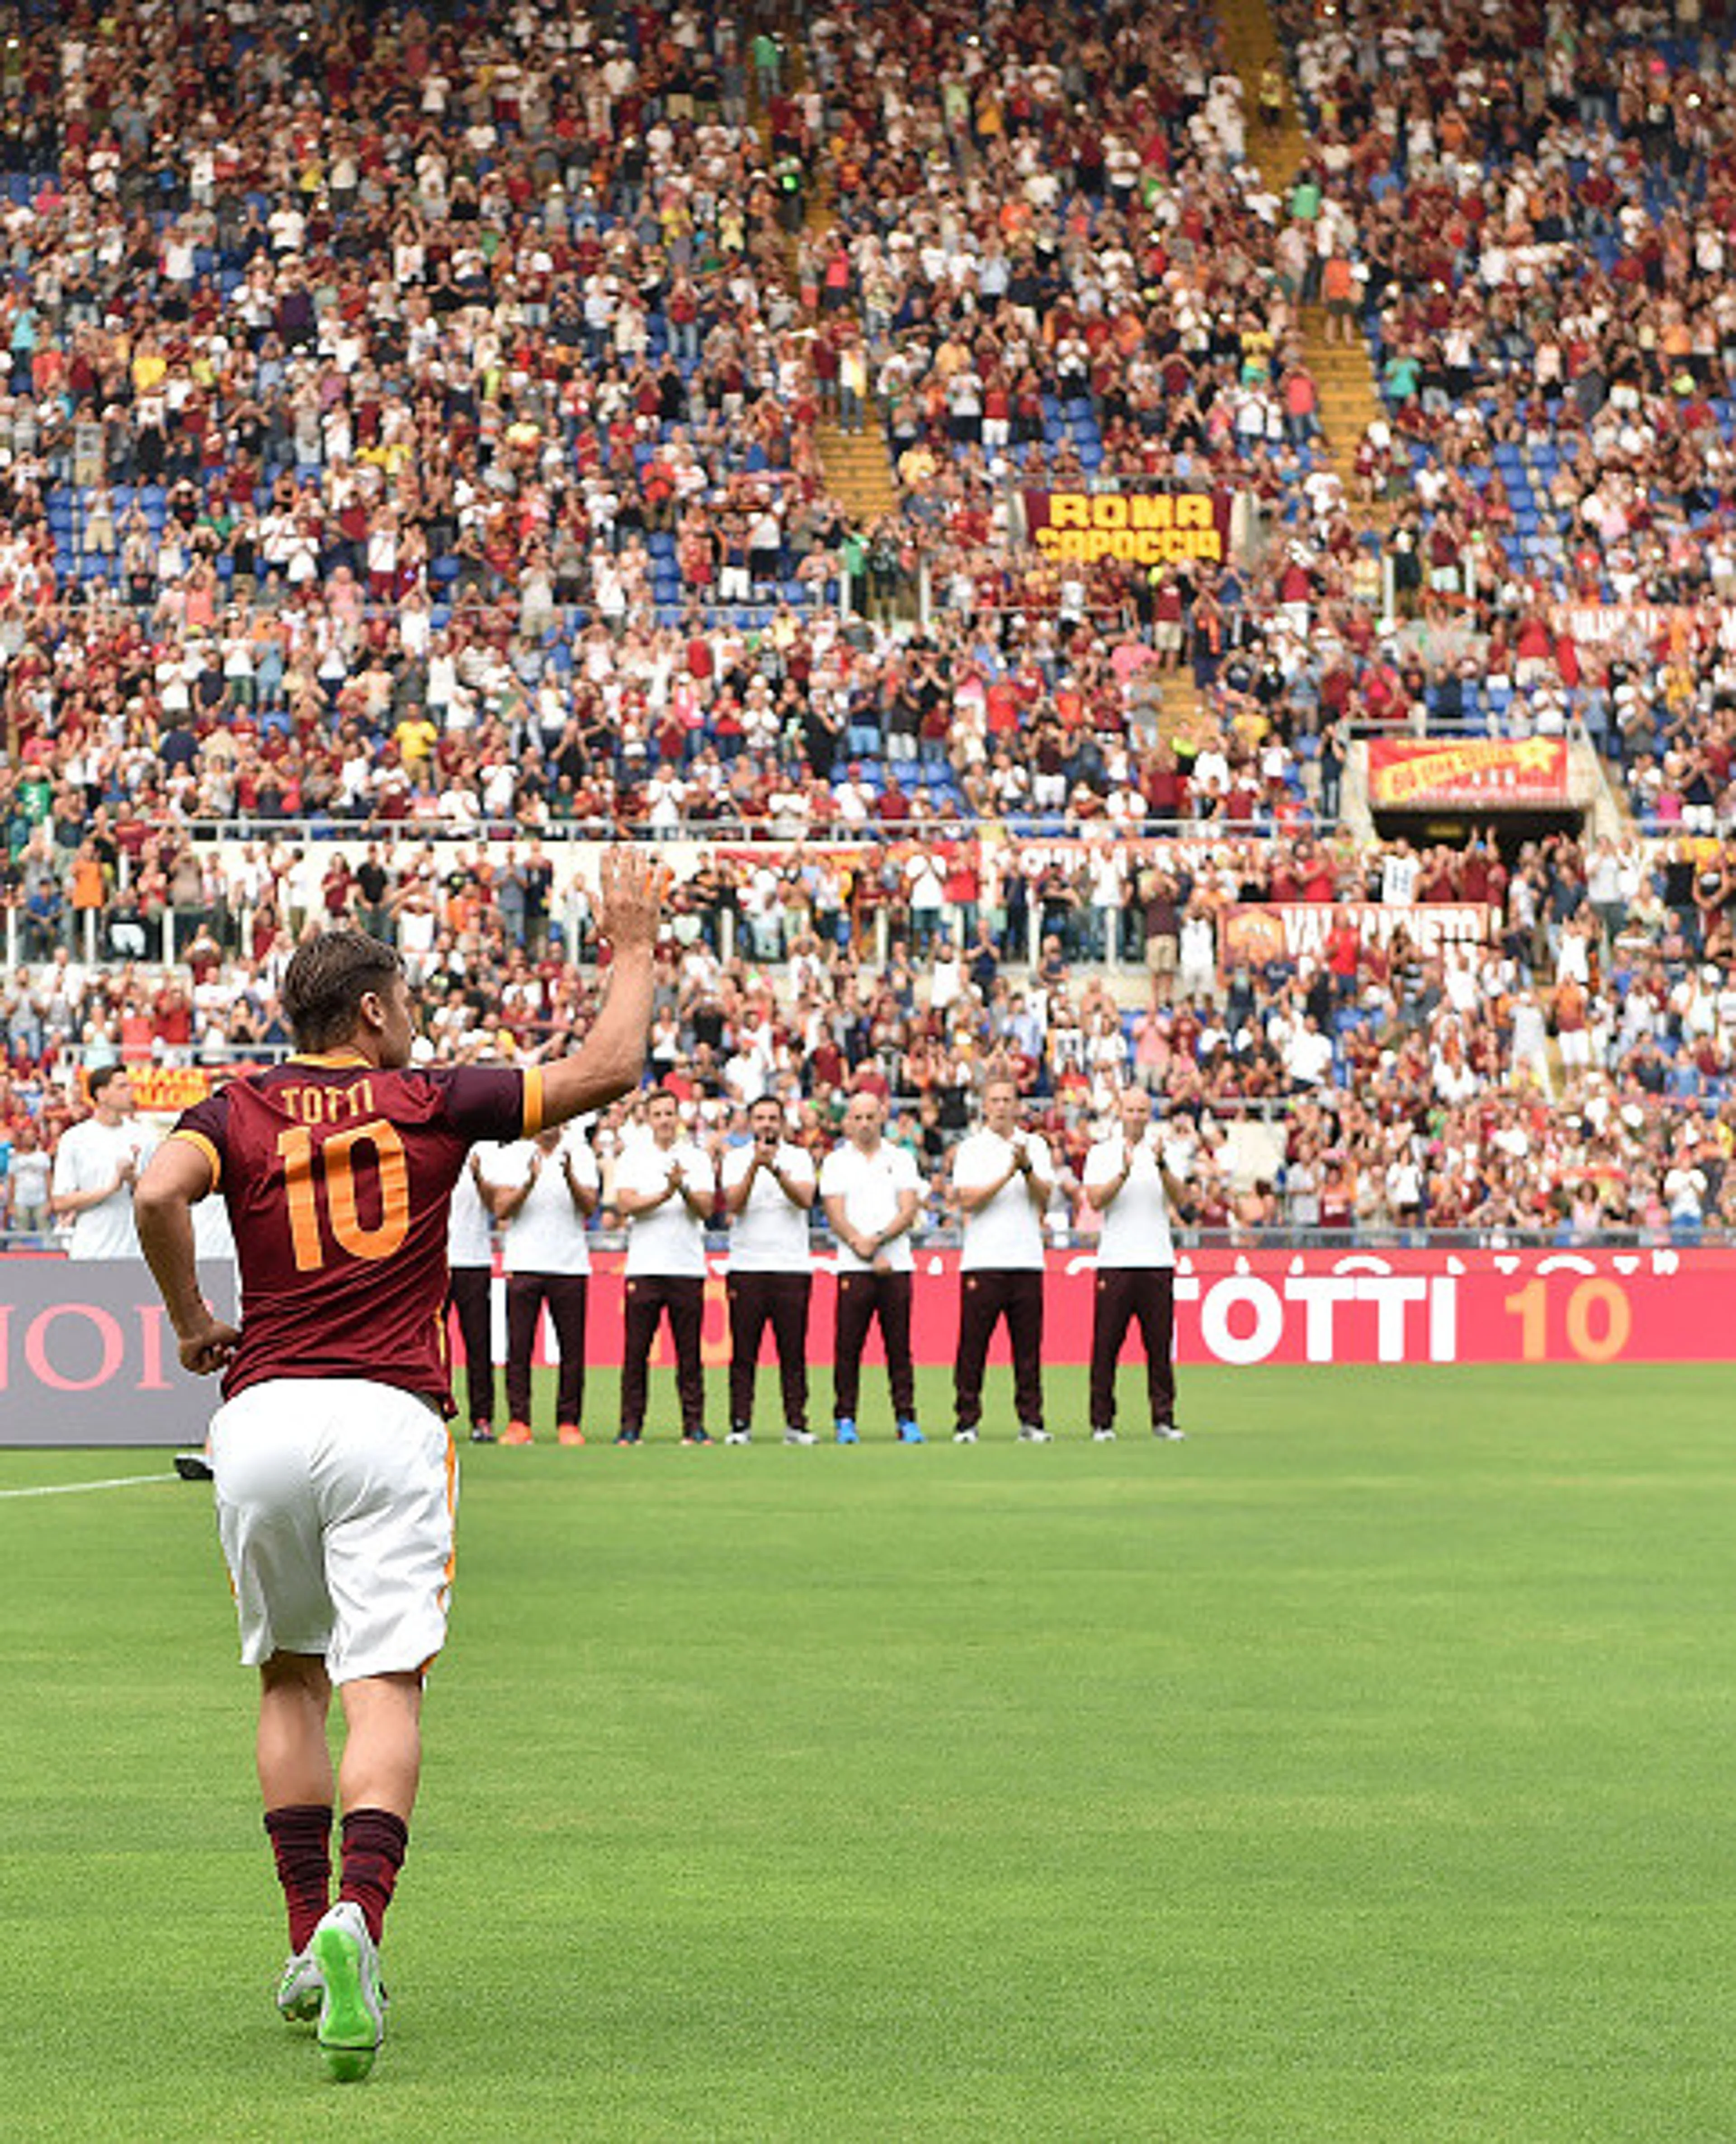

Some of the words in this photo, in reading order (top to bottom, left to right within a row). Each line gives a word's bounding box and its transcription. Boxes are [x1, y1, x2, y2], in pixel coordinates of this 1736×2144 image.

[1049, 494, 1213, 528] ROMA
[1035, 527, 1221, 564] CAPOCCIA
[281, 1079, 375, 1123] TOTTI
[277, 1118, 410, 1272] 10
[1505, 1278, 1630, 1362] 10
